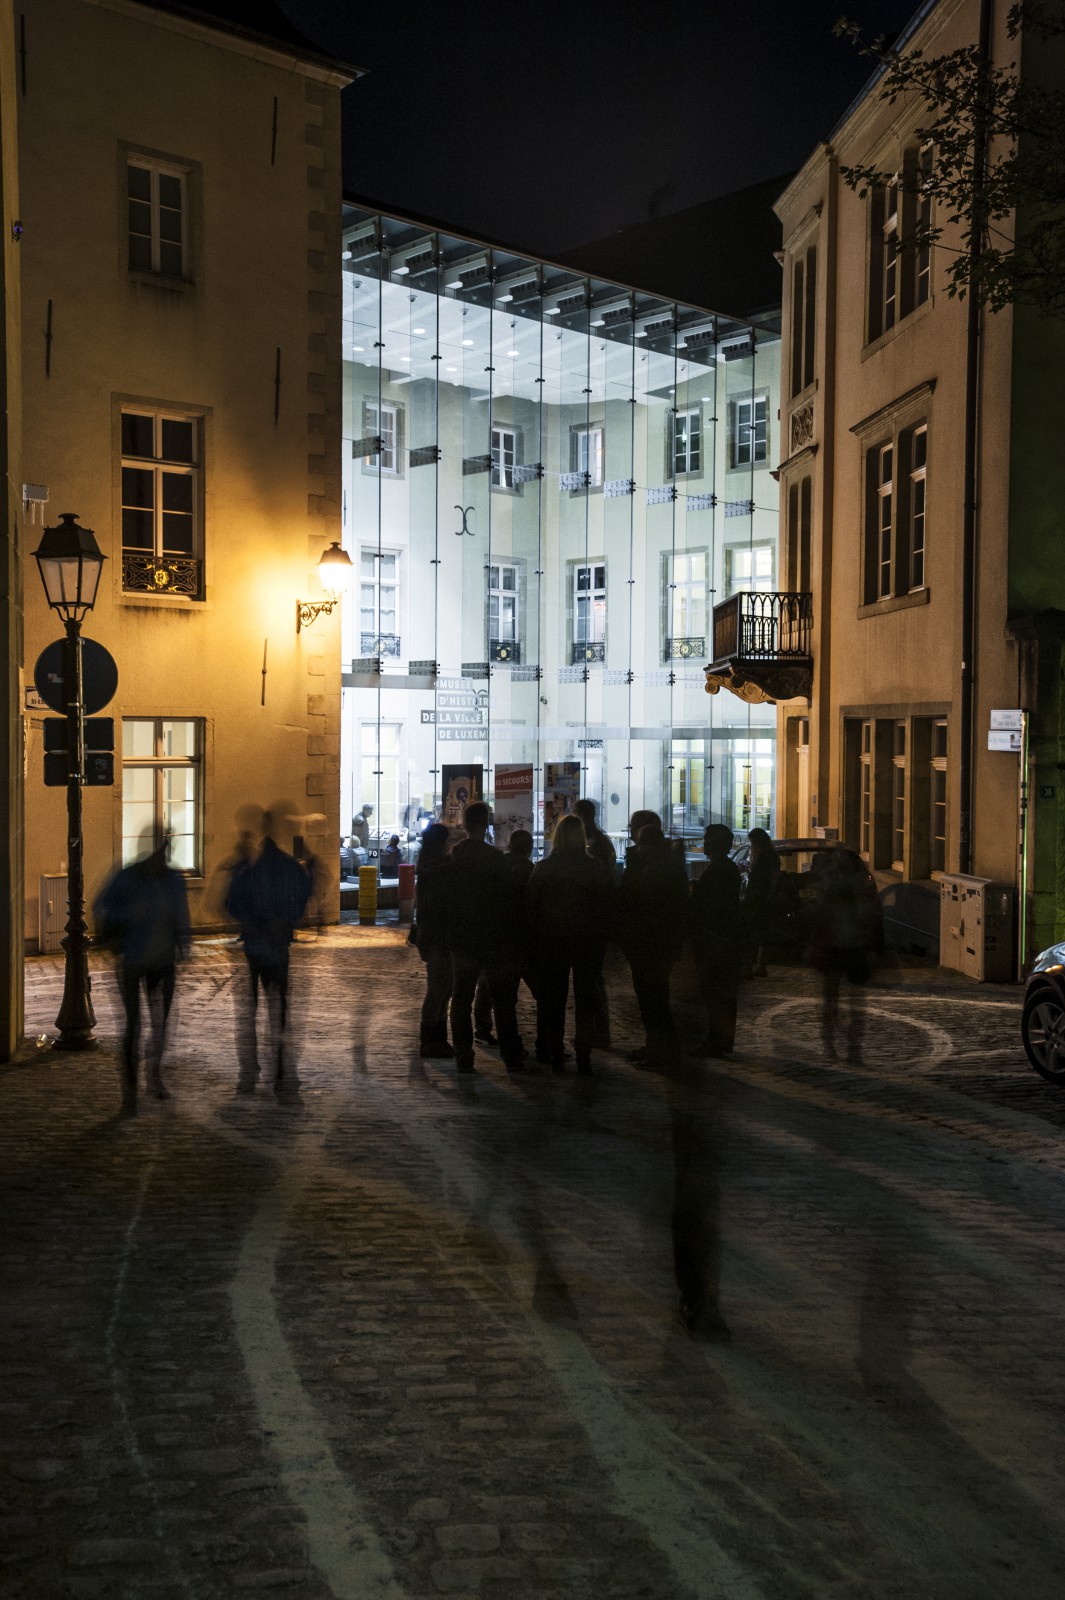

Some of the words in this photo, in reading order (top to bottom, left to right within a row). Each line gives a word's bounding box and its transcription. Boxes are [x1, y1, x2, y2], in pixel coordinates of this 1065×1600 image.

[439, 696, 489, 706] D'HISTOIR
[422, 713, 435, 723] DE
[440, 713, 452, 723] LA
[454, 713, 481, 723] VILLE
[439, 730, 451, 739] DE
[455, 730, 489, 739] LUXEM
